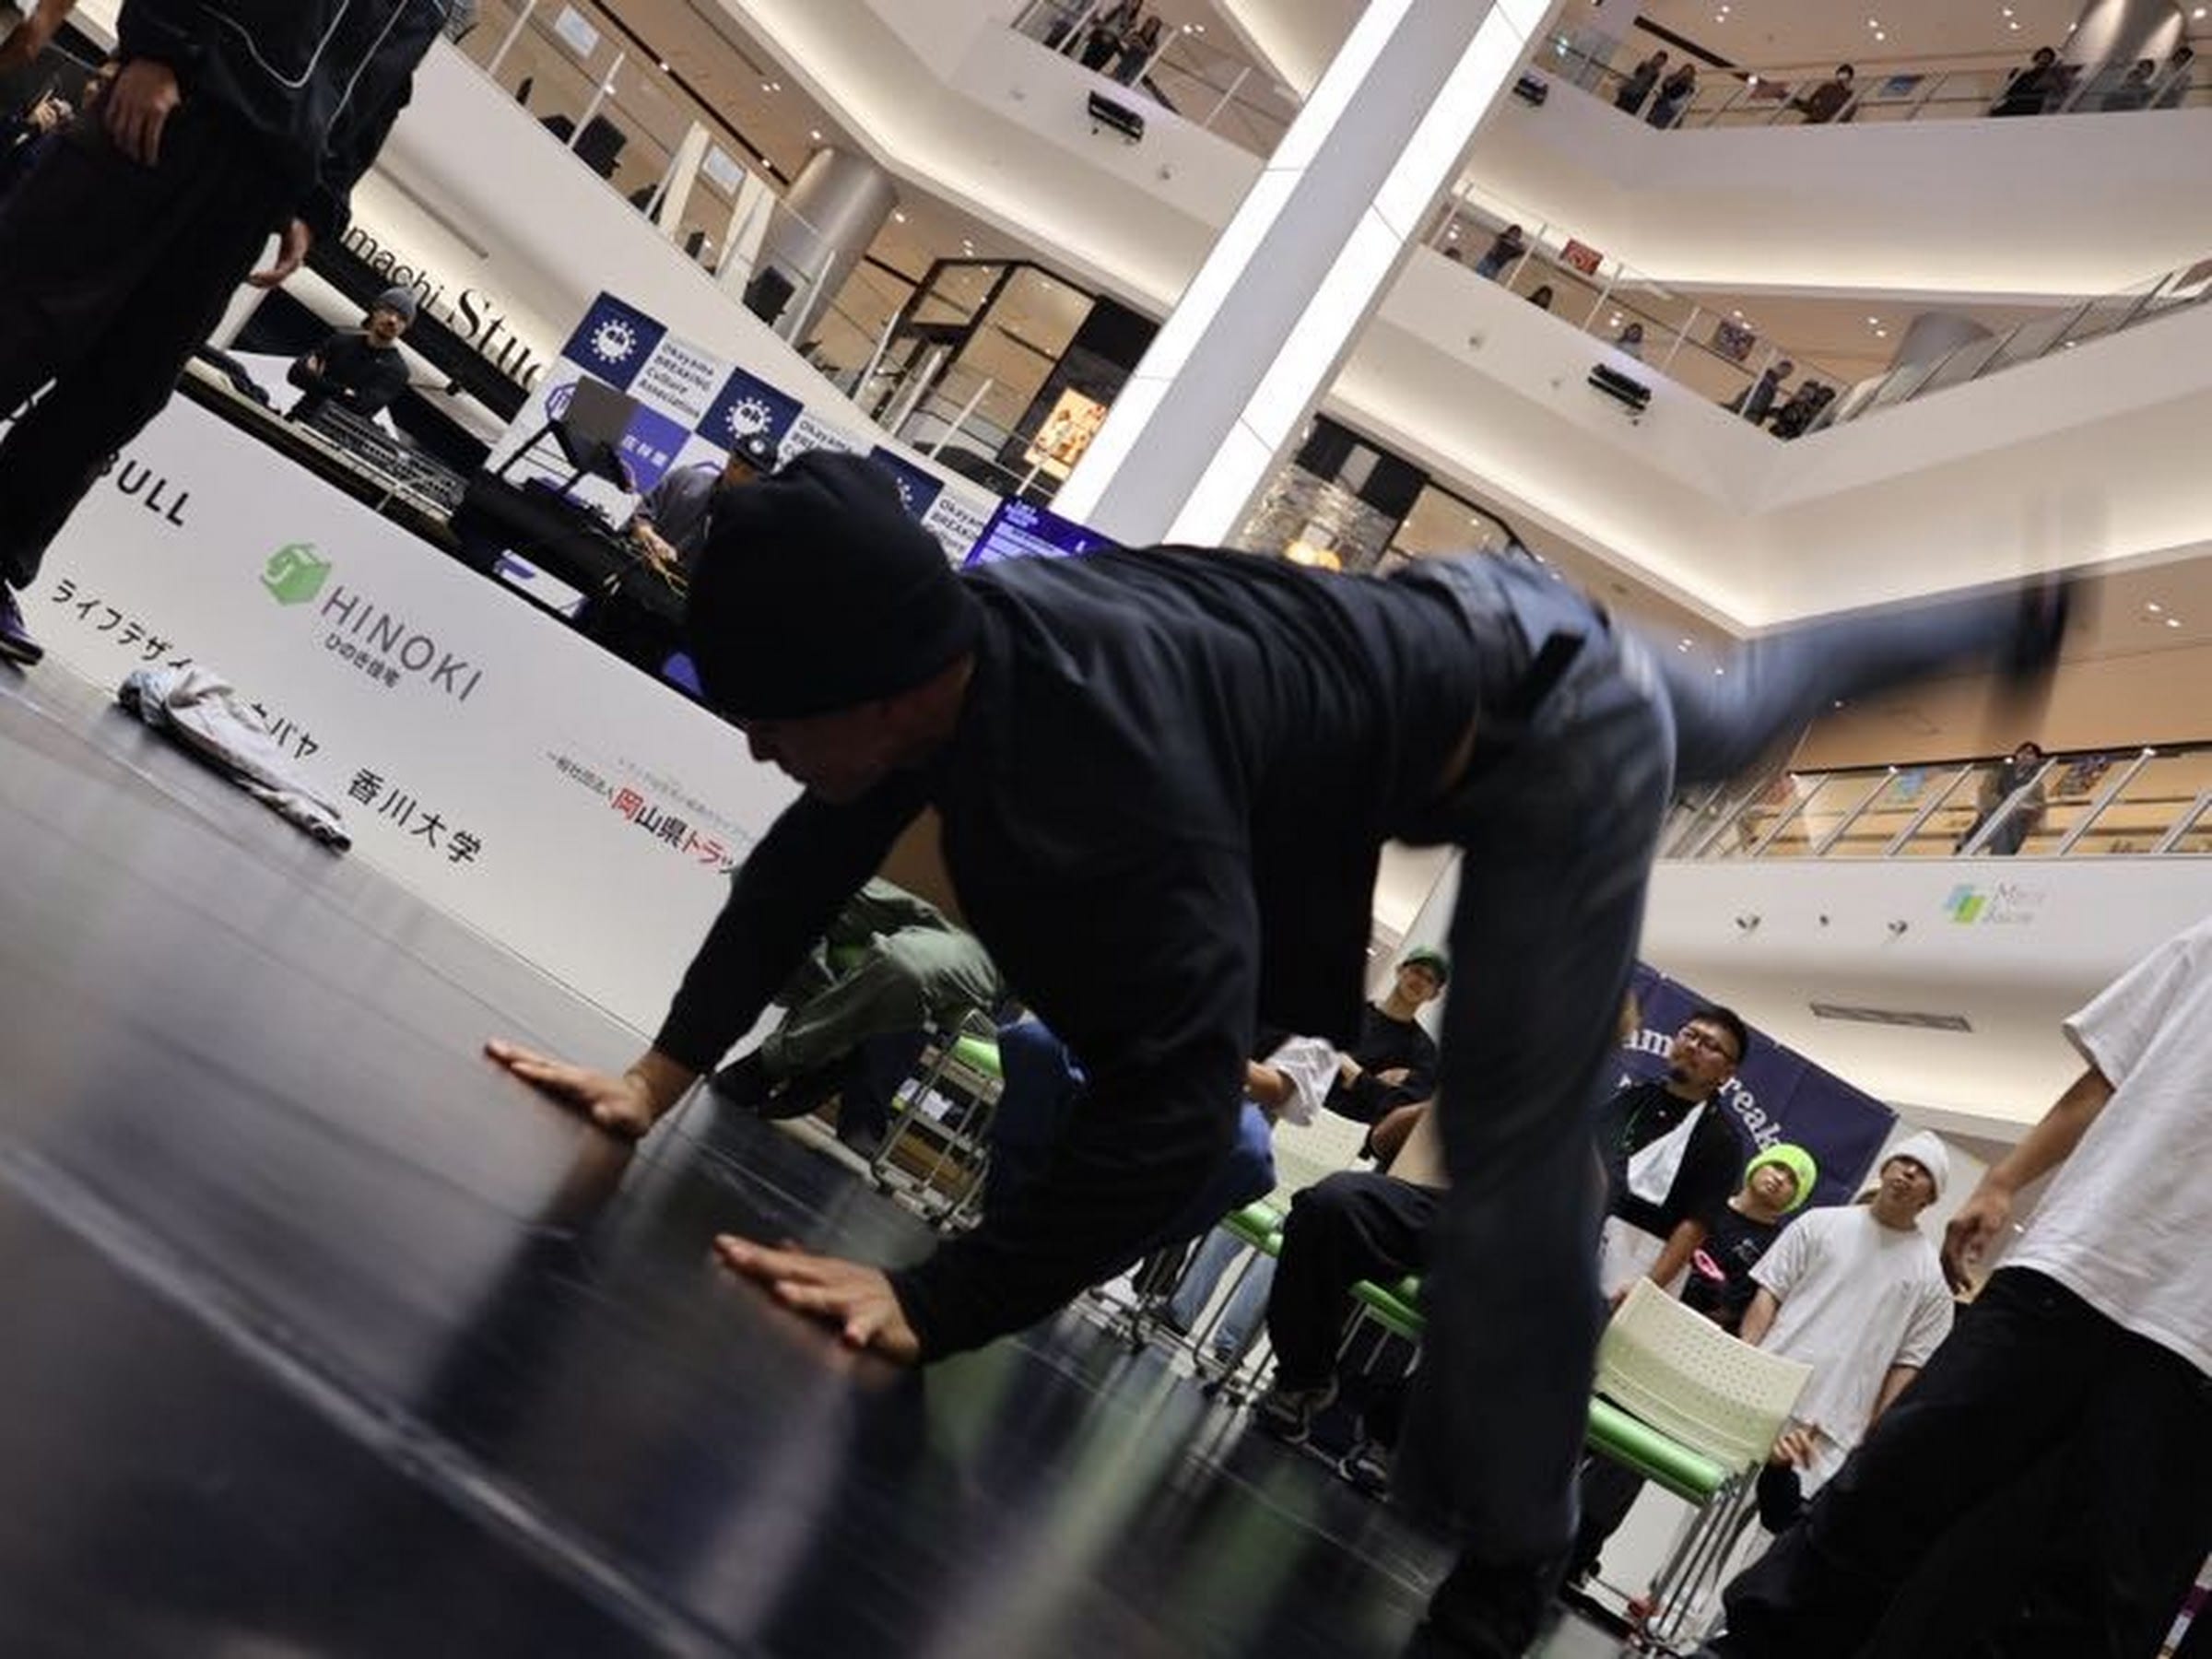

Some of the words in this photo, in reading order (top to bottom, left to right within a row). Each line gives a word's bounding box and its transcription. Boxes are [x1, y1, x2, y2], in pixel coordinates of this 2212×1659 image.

[340, 227, 445, 309] machi
[322, 586, 482, 701] HINOKI
[347, 768, 481, 863] 香川大学
